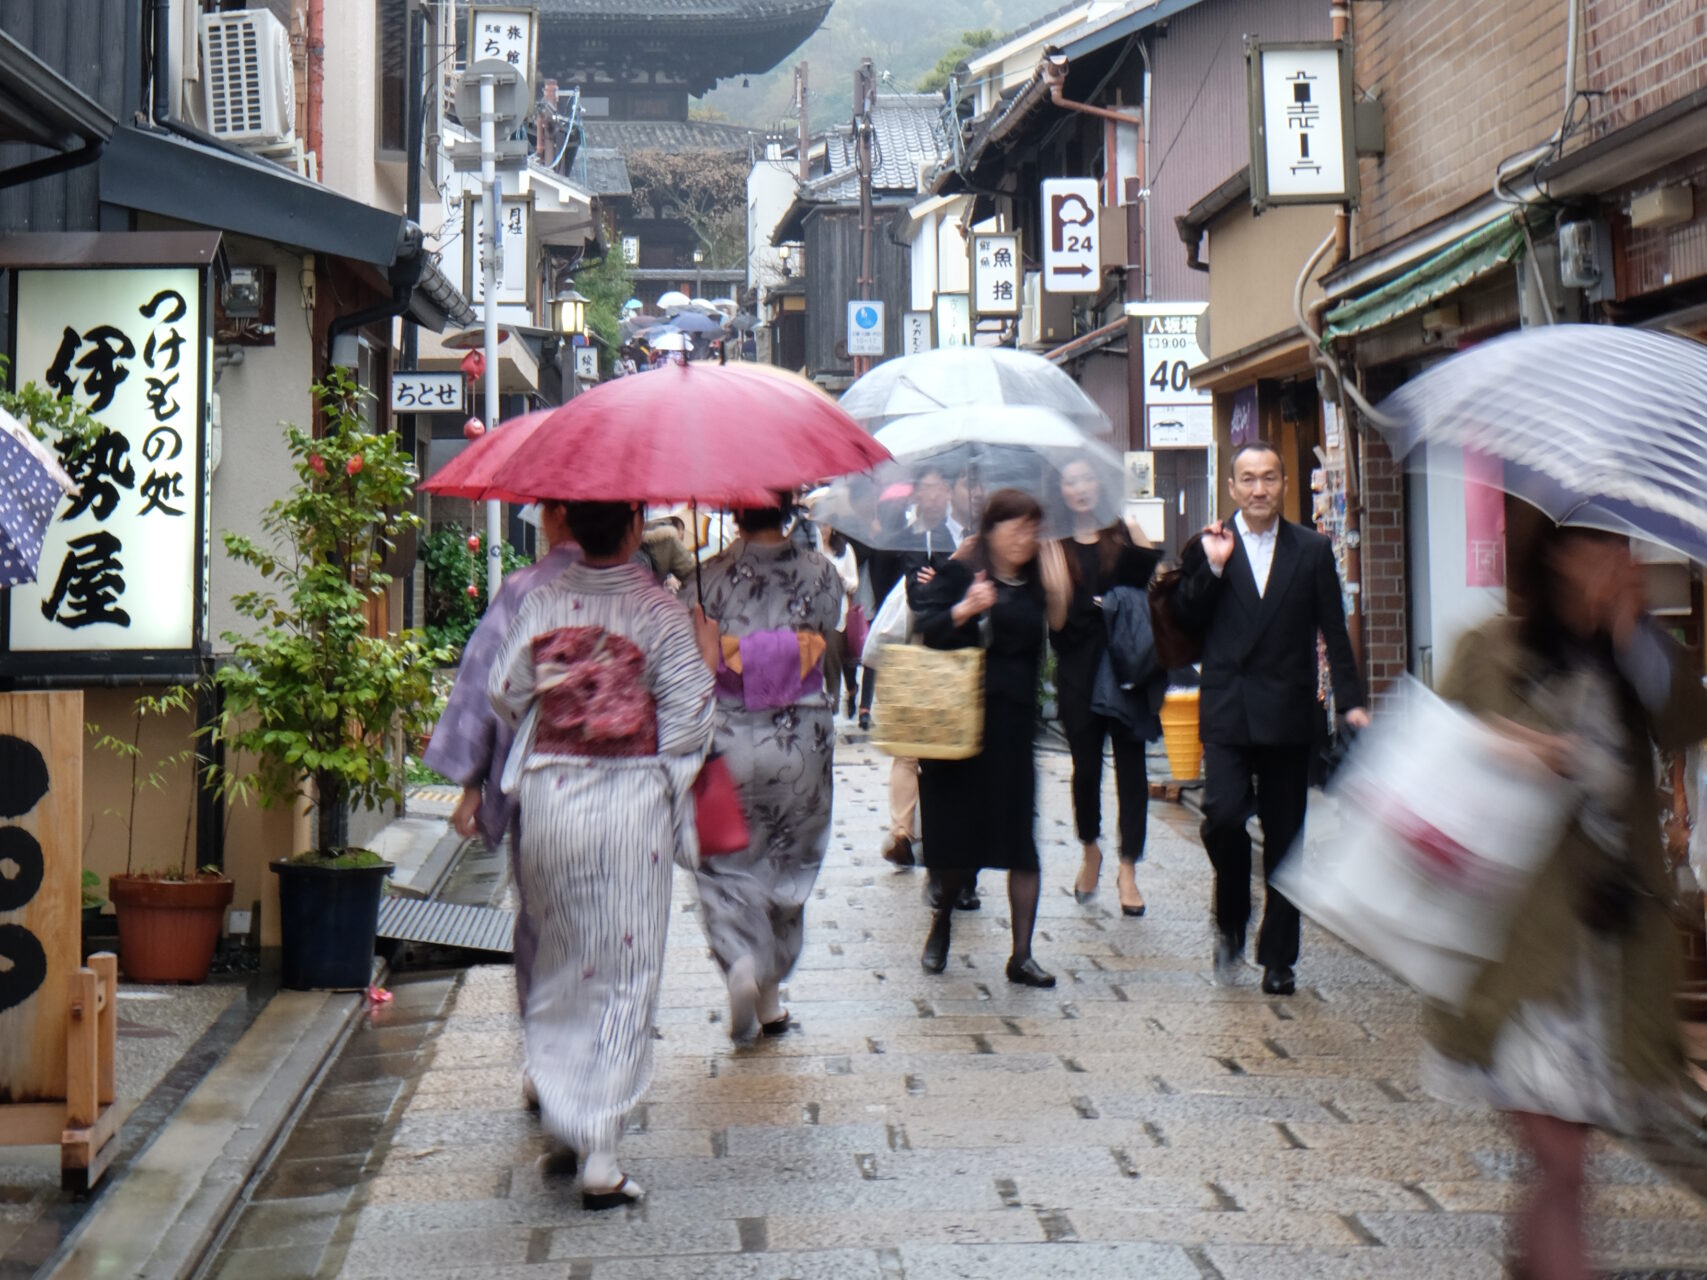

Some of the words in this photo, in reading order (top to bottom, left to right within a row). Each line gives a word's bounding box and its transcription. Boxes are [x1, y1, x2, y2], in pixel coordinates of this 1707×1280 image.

[484, 38, 500, 57] ち
[506, 24, 523, 64] 旅館
[1067, 236, 1093, 252] 24
[993, 247, 1013, 301] 魚捨
[1150, 360, 1197, 392] 40
[137, 289, 187, 517] つけもの処
[397, 382, 457, 407] ちとせ
[41, 324, 136, 629] 伊勢屋
